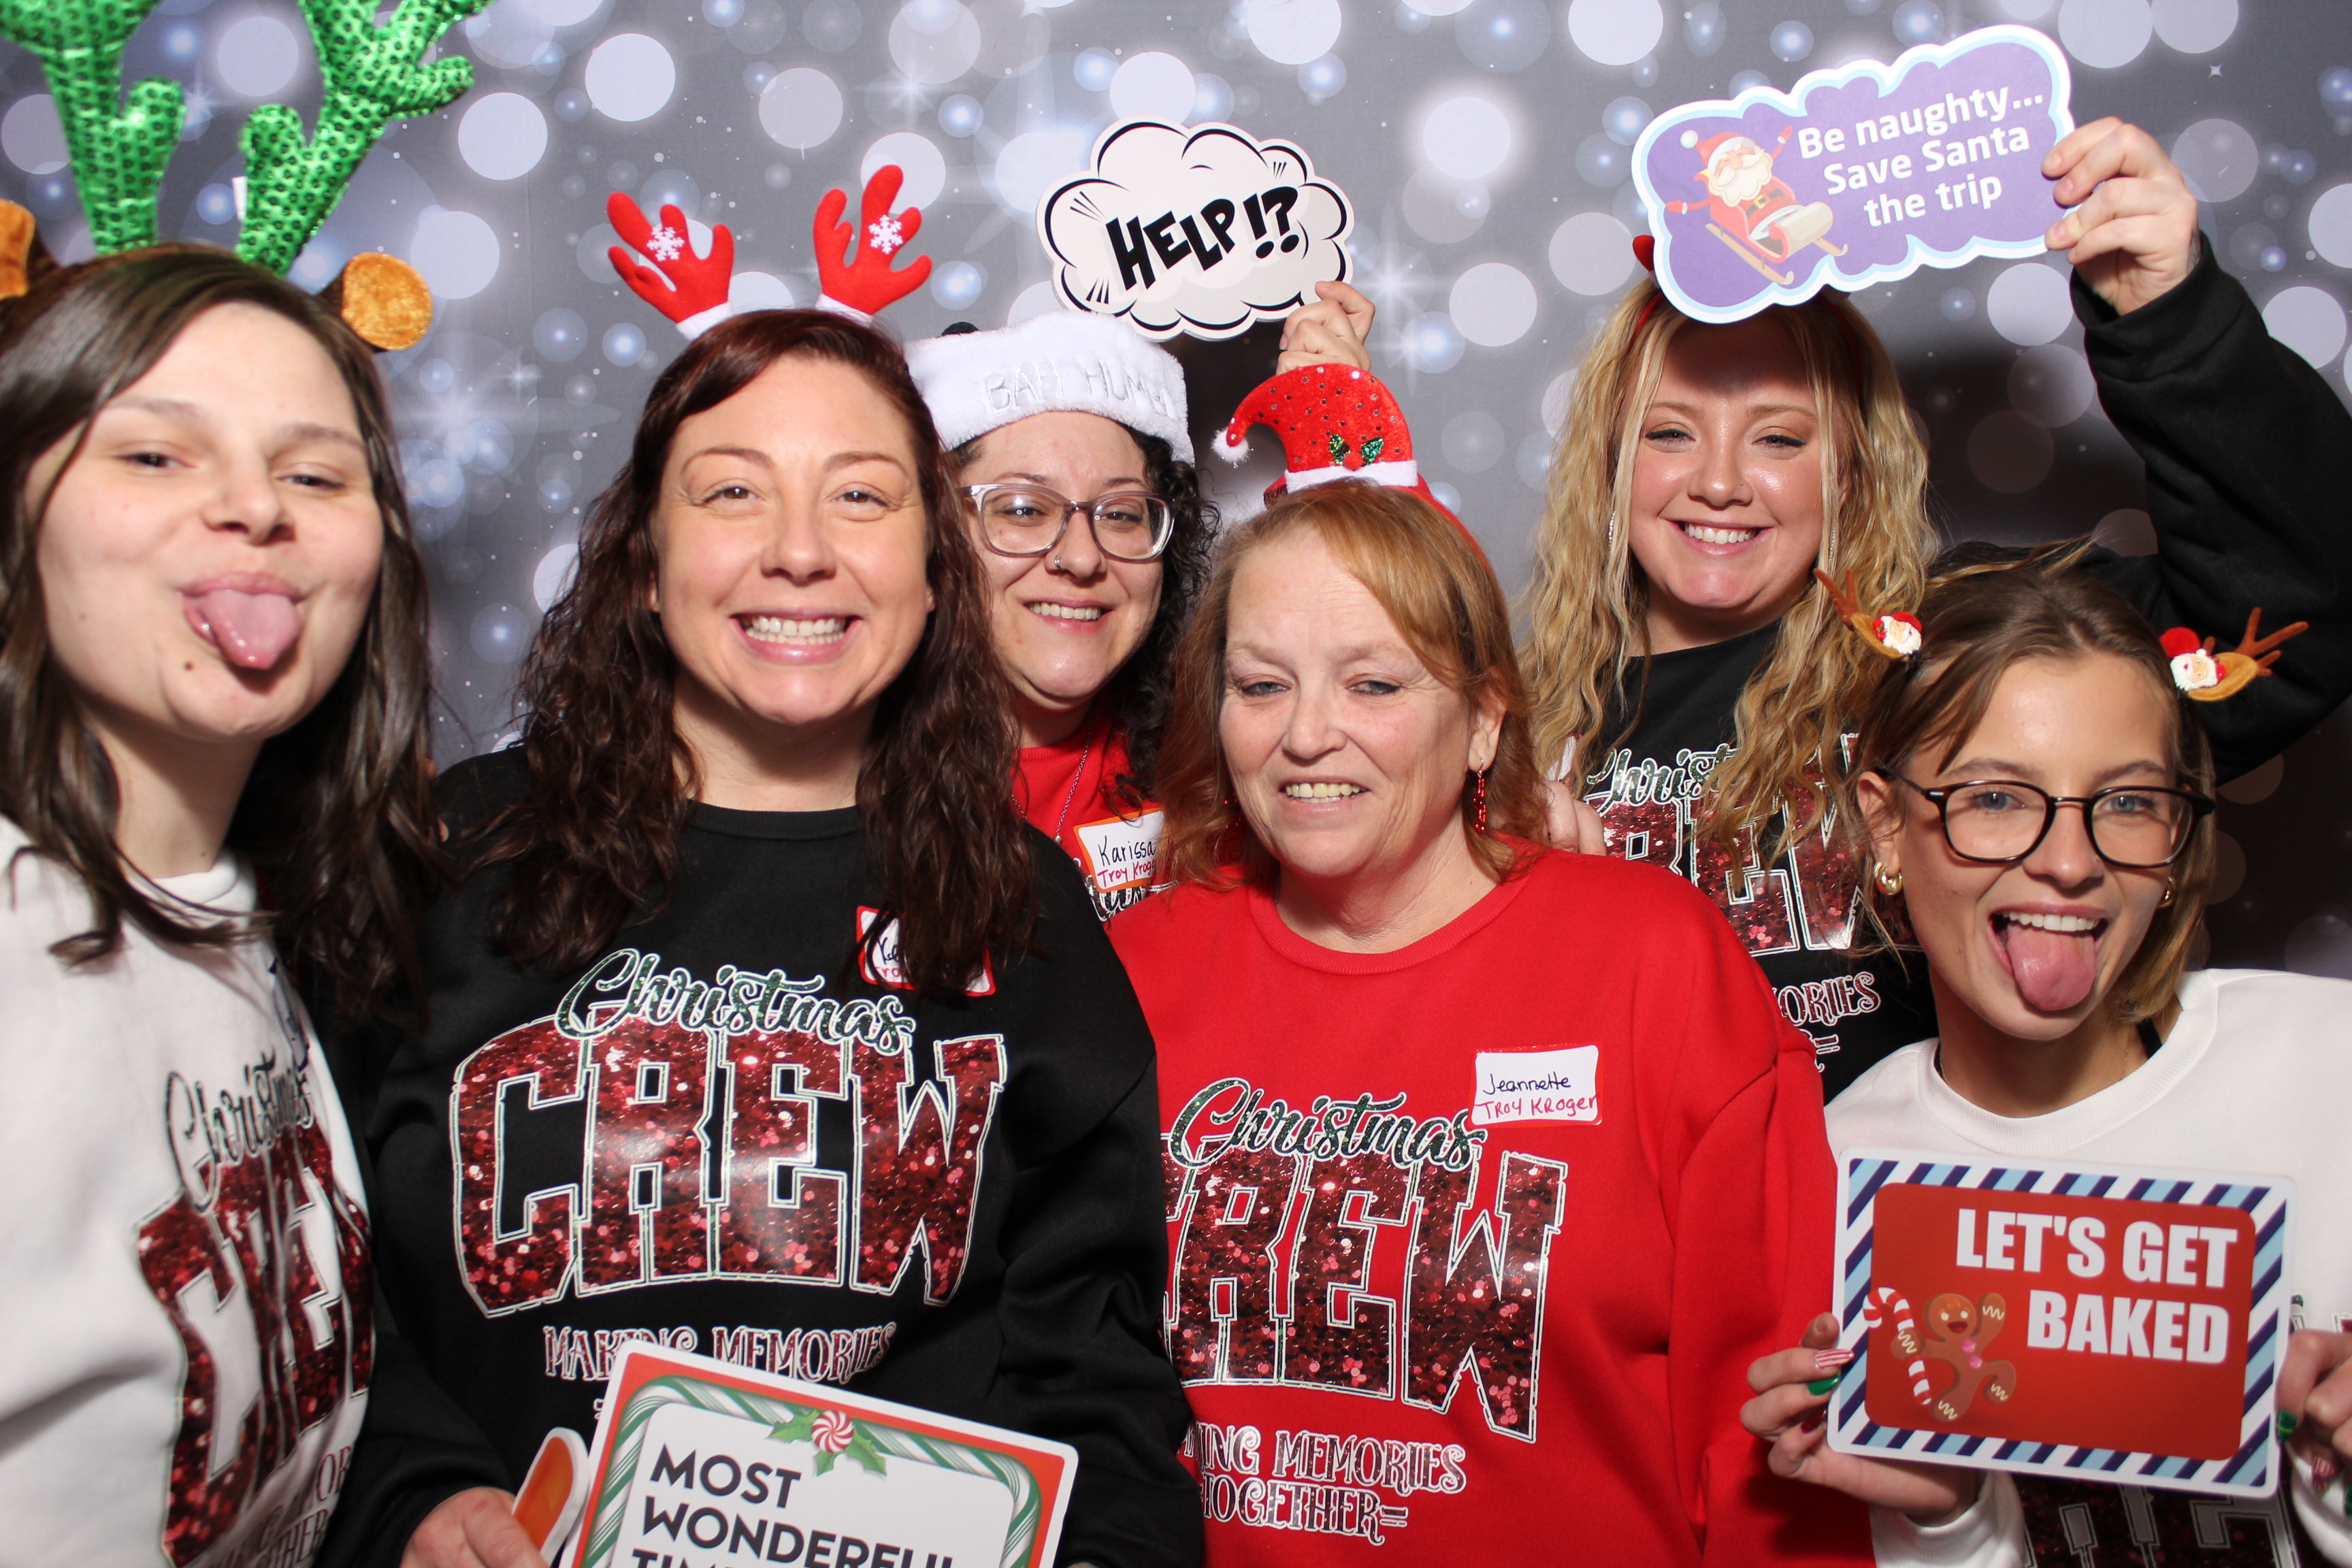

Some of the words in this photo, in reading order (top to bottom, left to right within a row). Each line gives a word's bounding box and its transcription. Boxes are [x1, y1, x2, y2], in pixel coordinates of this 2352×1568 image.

[1797, 127, 1845, 159] Be
[1855, 86, 2044, 148] naughty...
[1823, 155, 1912, 195] Save
[1921, 125, 2030, 172] Santa
[1863, 192, 1925, 227] the
[1935, 174, 2002, 212] trip
[983, 361, 1064, 414] BAH
[1097, 867, 1128, 888] Troy
[1098, 835, 1156, 867] Karissa
[555, 948, 917, 1057] Christmas
[1772, 971, 1882, 1026] ORIES
[1482, 1071, 1571, 1095] Jeannette
[1166, 1077, 1488, 1172] Christmas
[449, 1002, 1008, 1319] CREW
[1956, 1208, 2106, 1278] LET'S
[2122, 1221, 2238, 1288] GET
[2027, 1289, 2229, 1365] BAKED
[650, 1443, 802, 1509] MOST
[1273, 1429, 1467, 1497] MEMORIES
